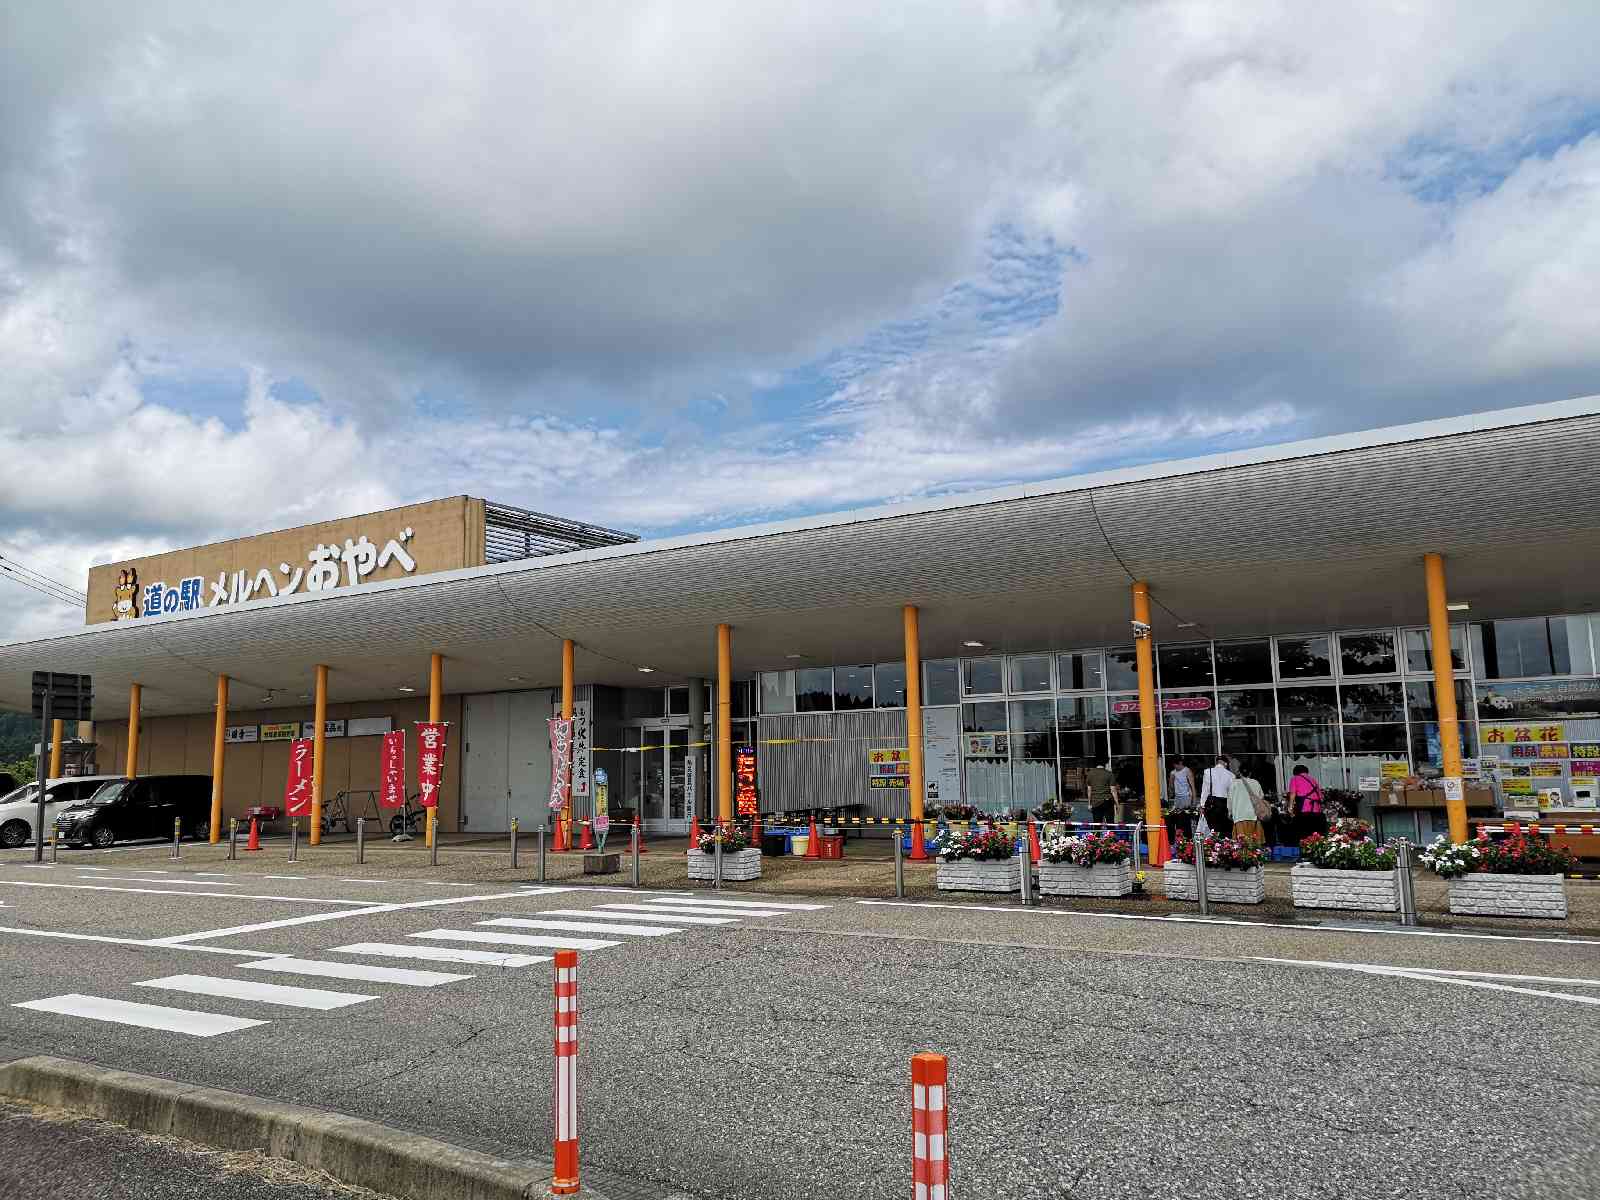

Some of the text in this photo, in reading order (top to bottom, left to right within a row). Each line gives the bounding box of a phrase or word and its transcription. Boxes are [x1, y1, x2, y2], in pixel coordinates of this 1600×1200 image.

[143, 527, 415, 617] 道の駅 メルヘンおやべ
[421, 727, 440, 801] 営業中
[1487, 725, 1559, 743] お盆花
[287, 744, 308, 813] ラーメン
[385, 737, 399, 802] いらっしゃいませ
